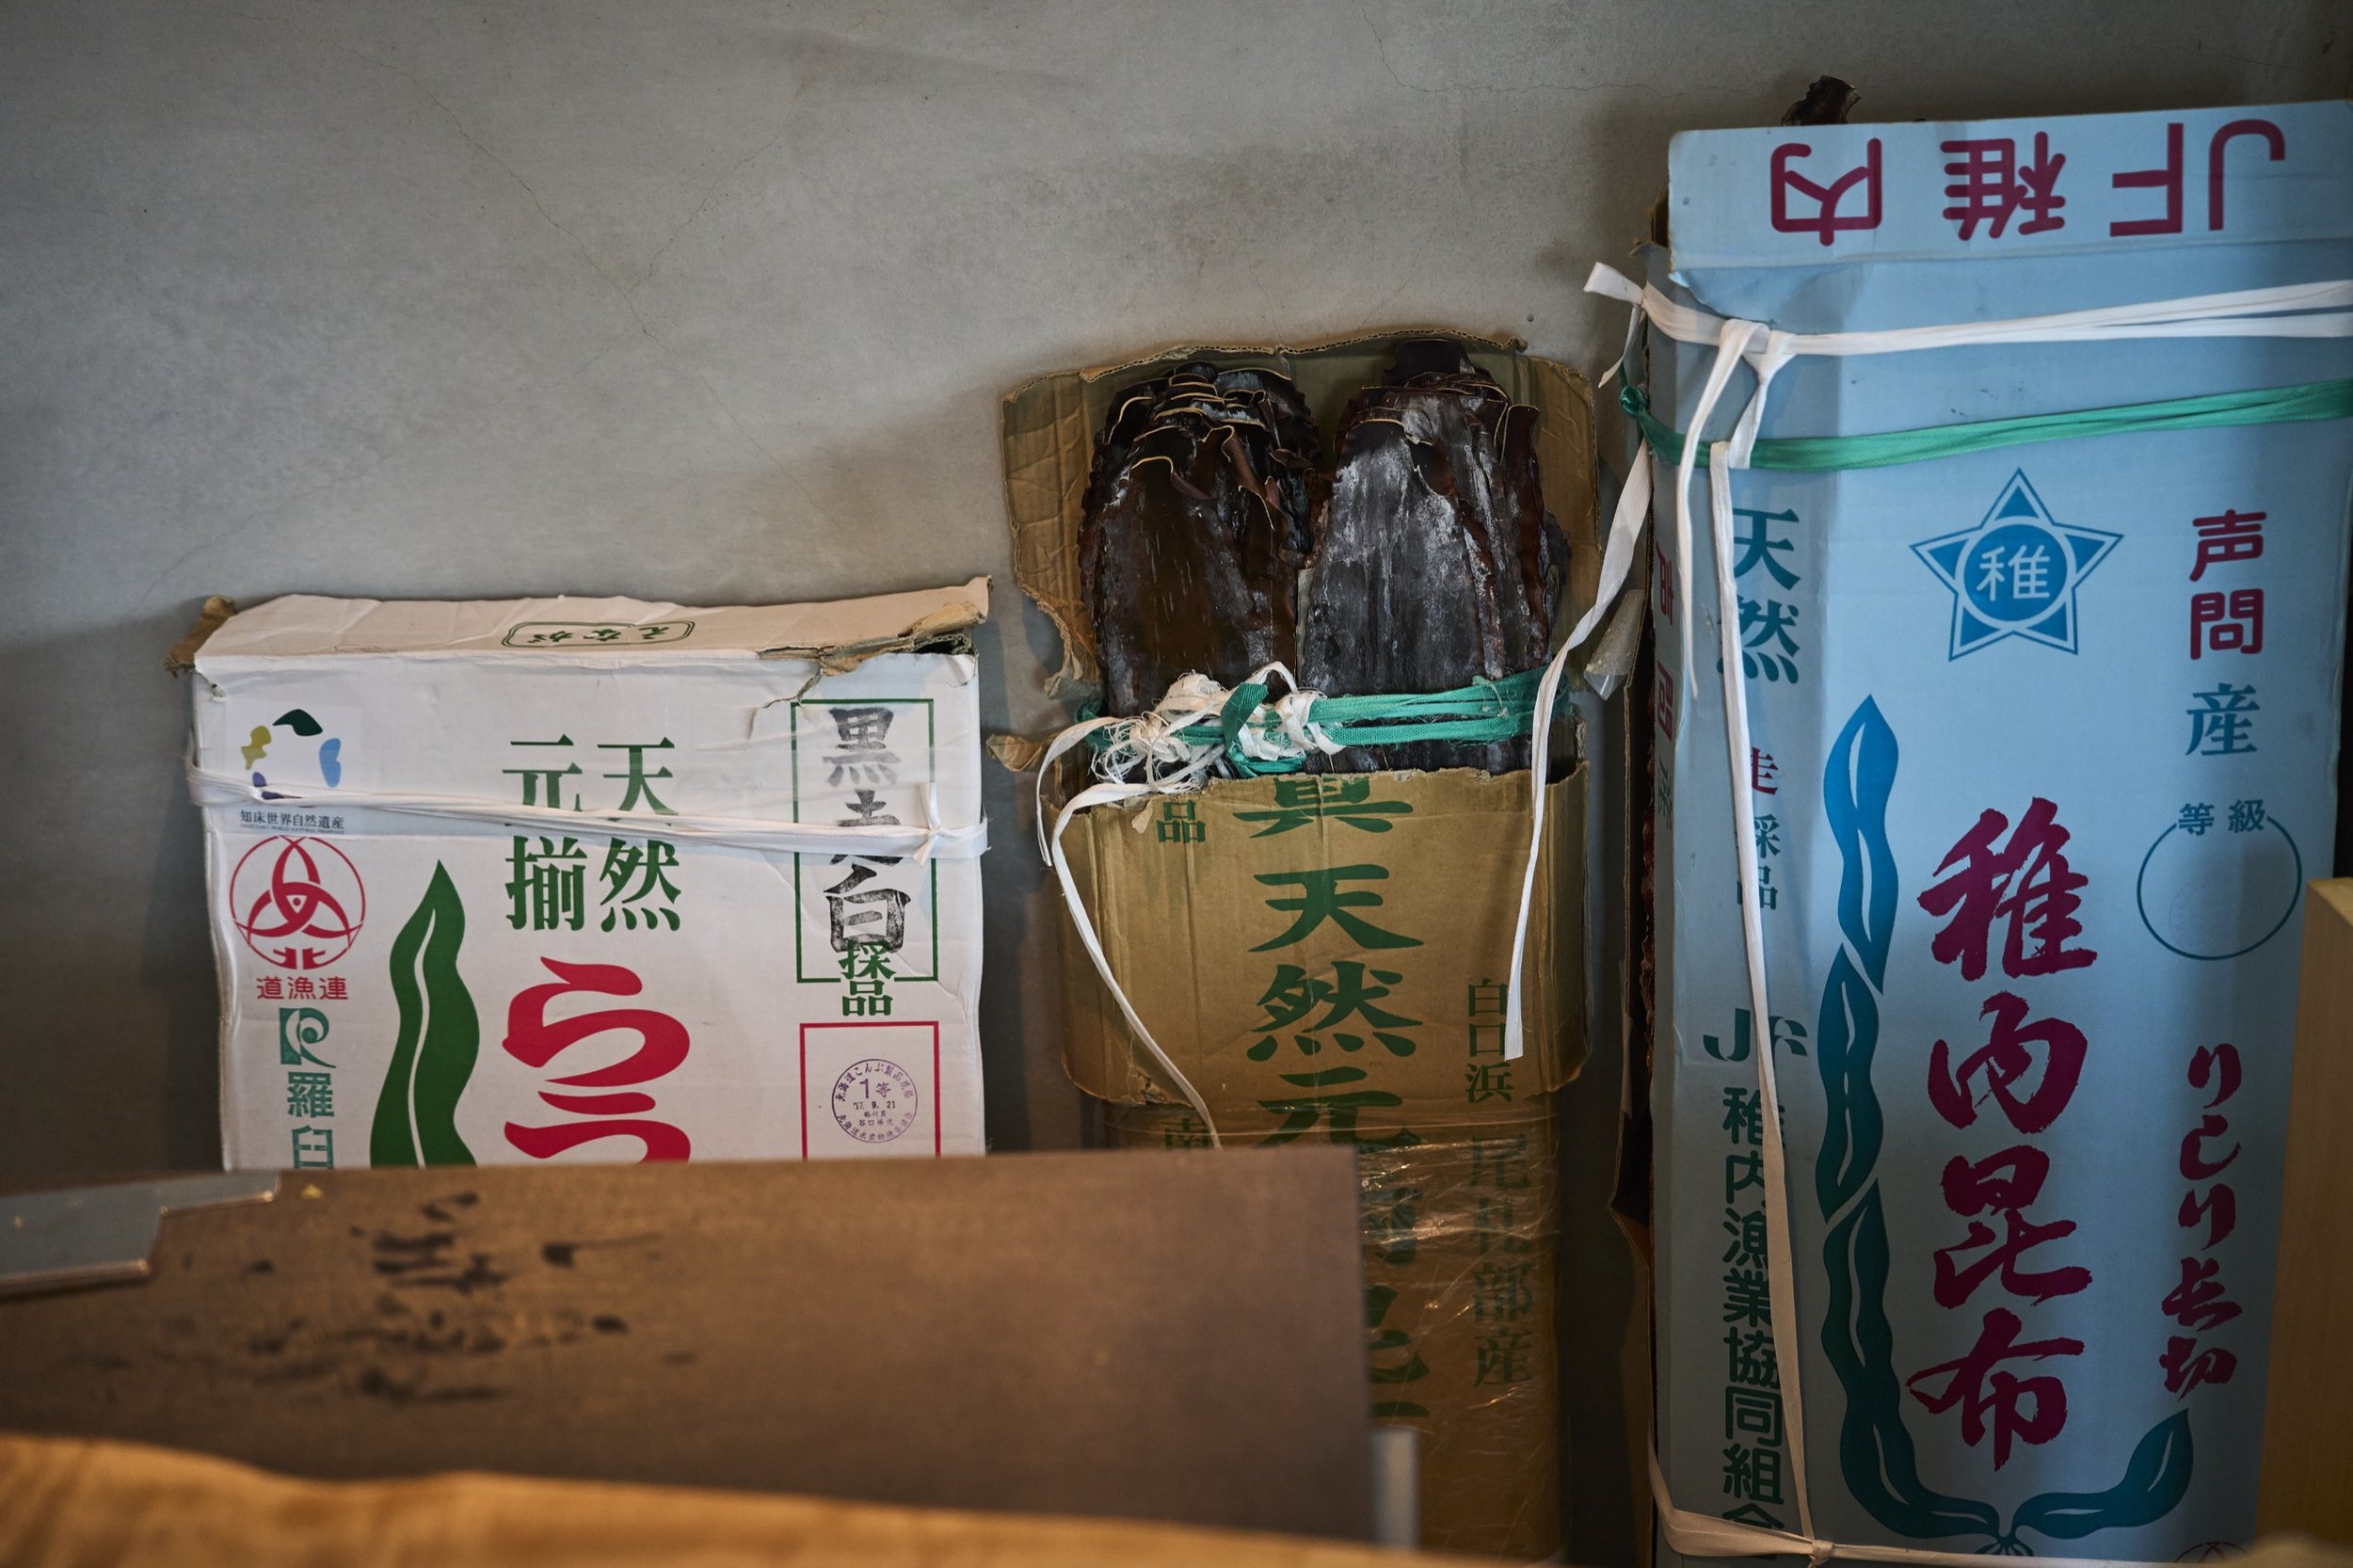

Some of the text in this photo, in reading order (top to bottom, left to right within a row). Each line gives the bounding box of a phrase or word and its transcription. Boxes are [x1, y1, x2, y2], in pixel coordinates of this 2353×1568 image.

[1717, 508, 1801, 684] 天然
[1977, 545, 2051, 602] 稚
[240, 809, 344, 829] 知床世界自然遺産
[598, 736, 681, 932] 天然
[1157, 799, 1206, 844] 品
[2178, 799, 2266, 837] 等級
[256, 976, 349, 1000] 道漁連
[1906, 796, 2098, 1473] 稚内昆布
